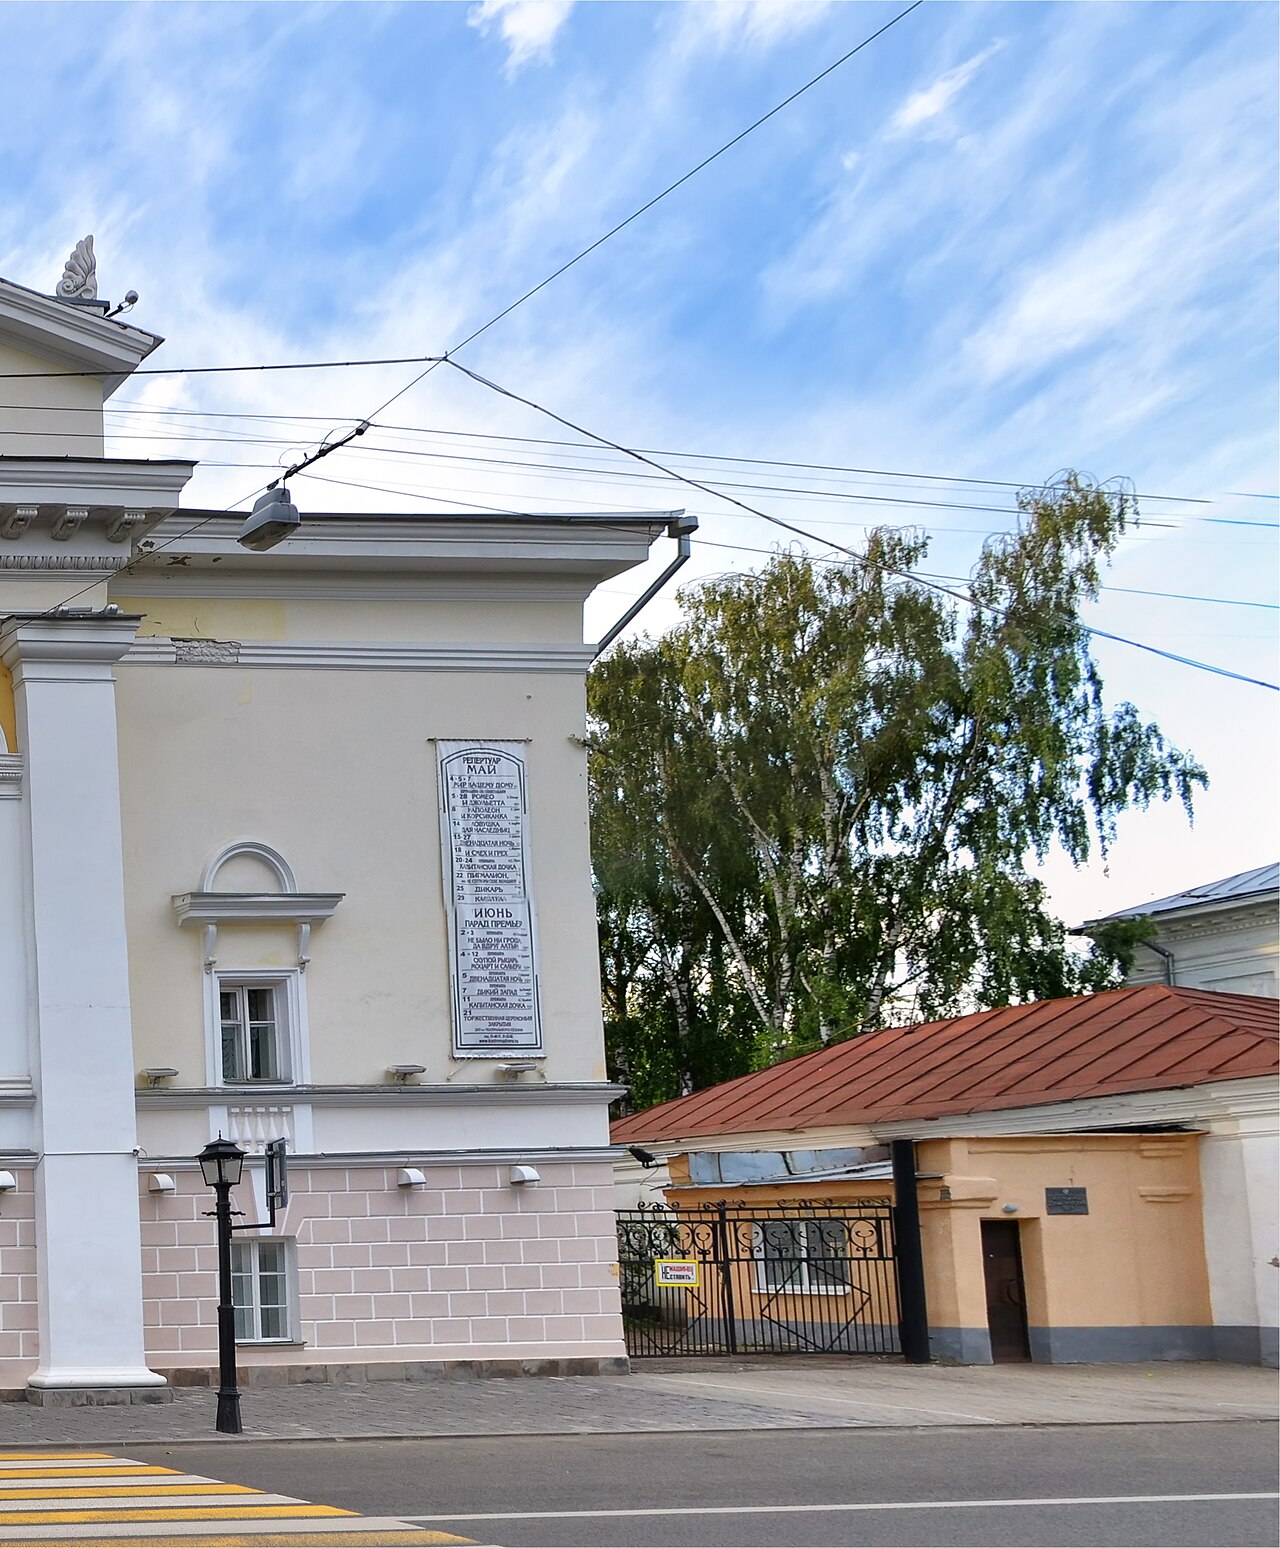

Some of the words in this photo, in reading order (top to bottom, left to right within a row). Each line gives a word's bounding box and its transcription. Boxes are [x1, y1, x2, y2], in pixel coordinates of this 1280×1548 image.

[462, 757, 501, 765] РЕПЕРТУАР
[467, 764, 496, 774] МАЙ
[474, 908, 513, 918] ИЮНЬ
[465, 920, 489, 928] ПАРАД
[491, 920, 523, 928] ПРЕМЬЕР
